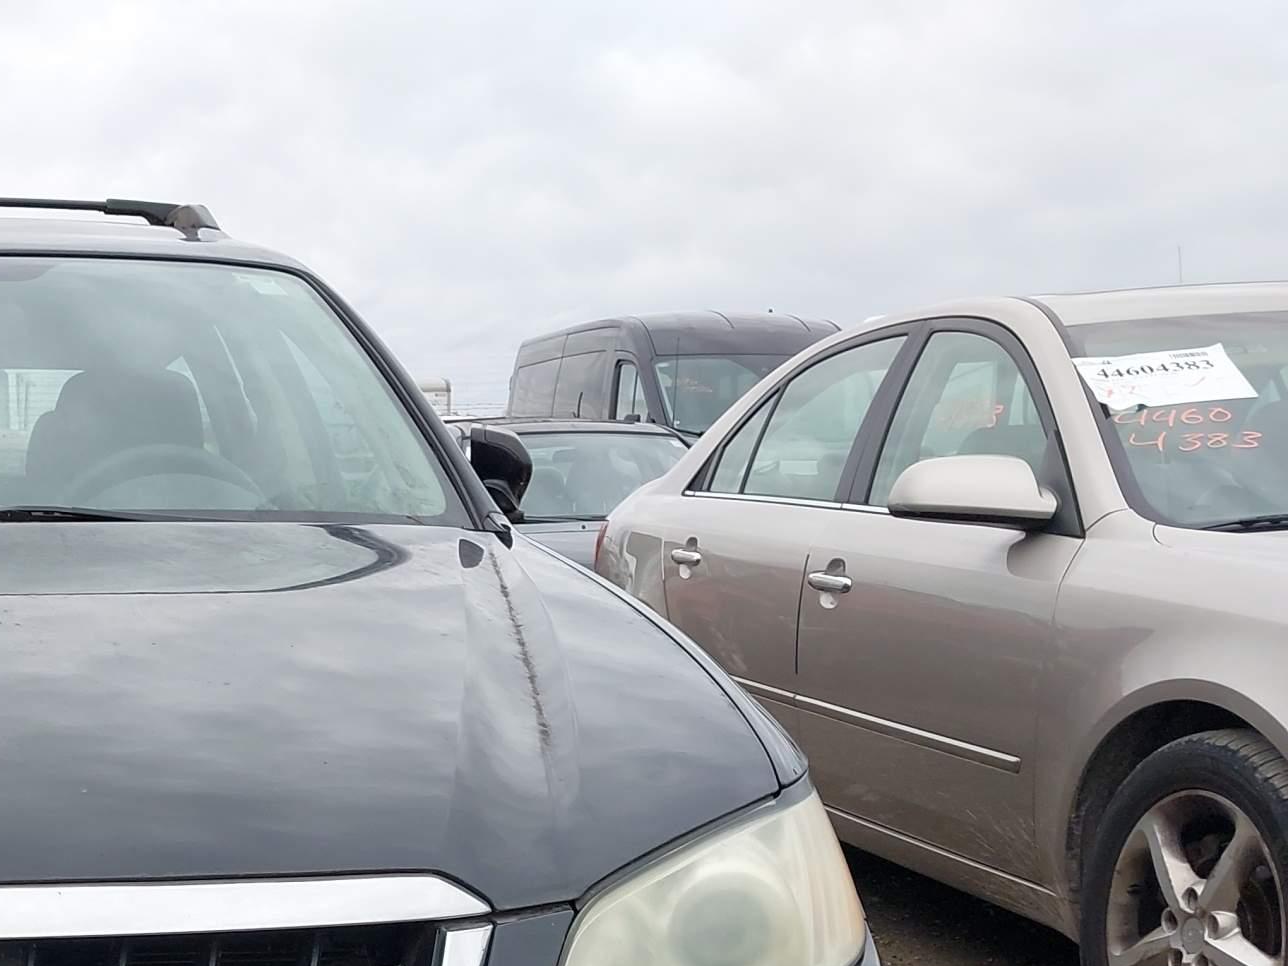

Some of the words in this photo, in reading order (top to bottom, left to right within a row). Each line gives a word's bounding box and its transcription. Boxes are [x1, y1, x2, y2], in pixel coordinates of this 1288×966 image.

[1097, 359, 1214, 379] 44604383
[1114, 407, 1232, 427] 4460
[1128, 431, 1263, 452] 4383
